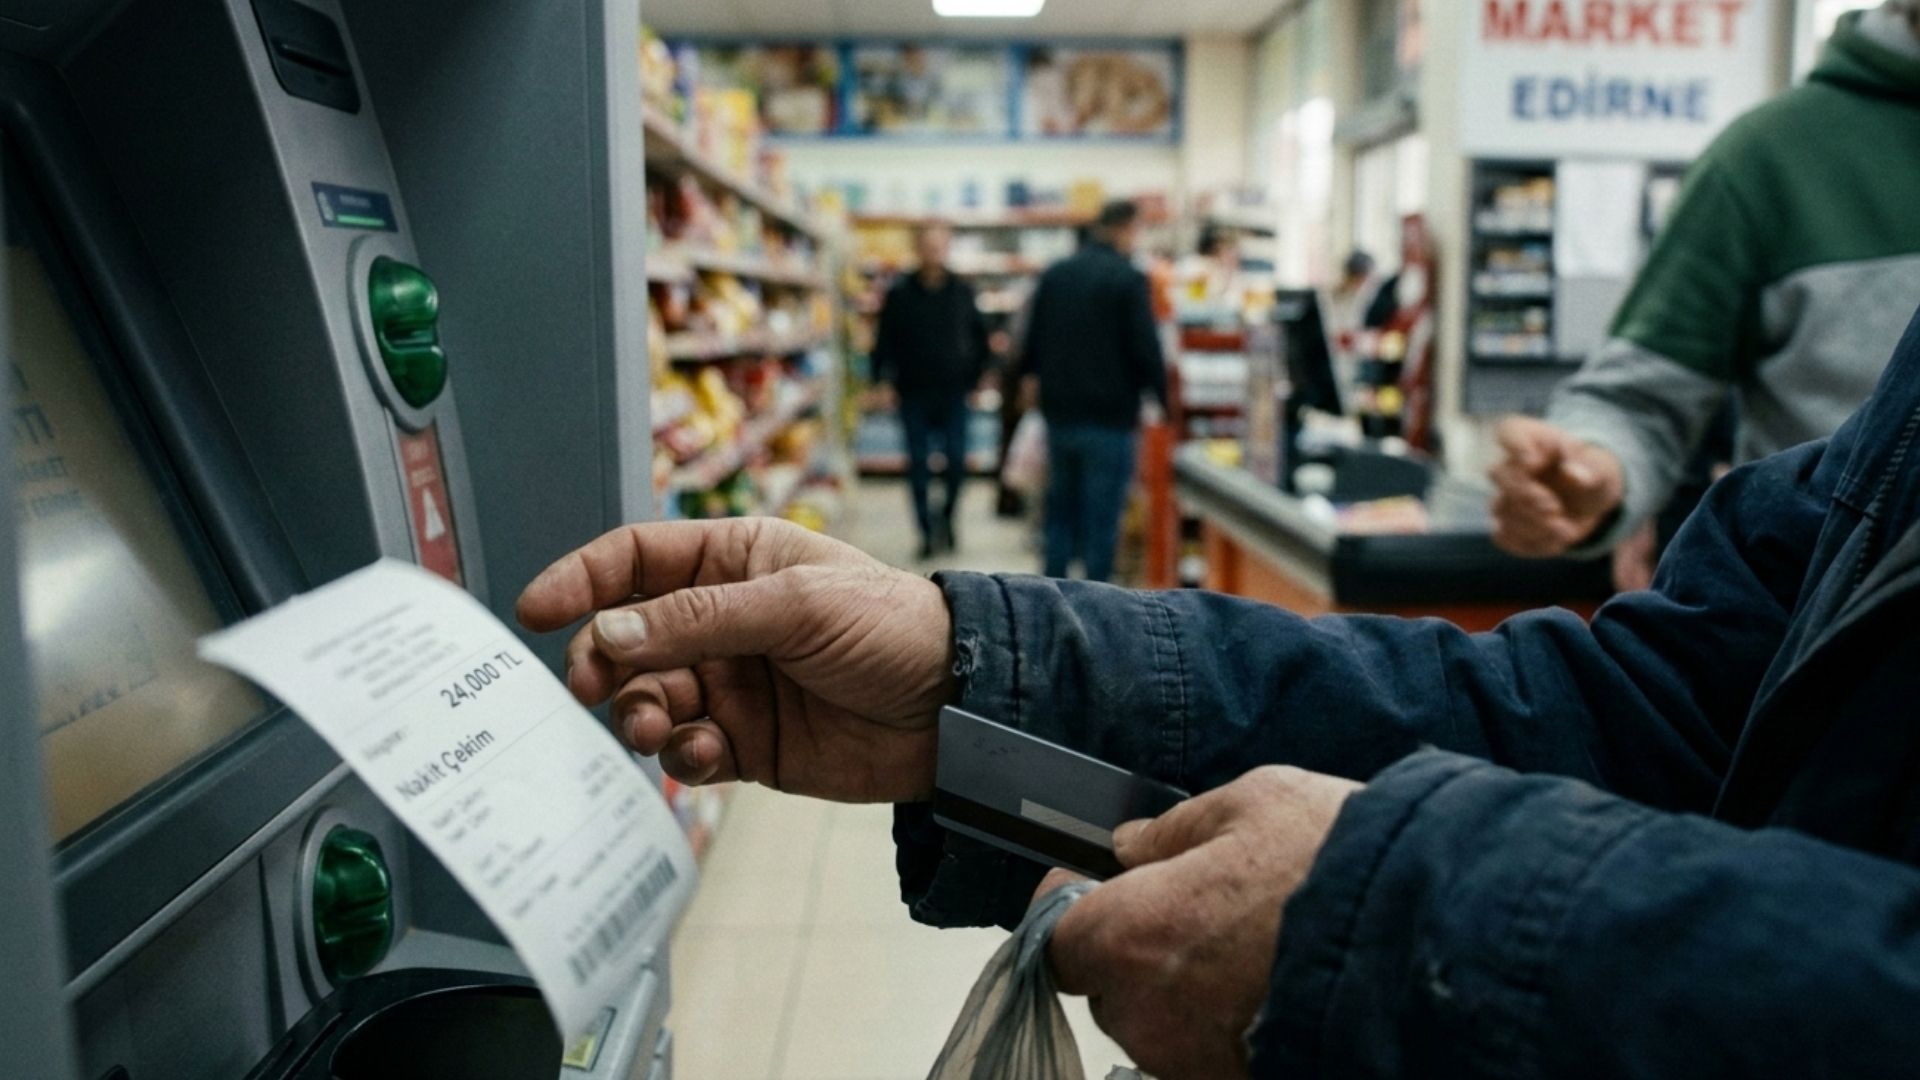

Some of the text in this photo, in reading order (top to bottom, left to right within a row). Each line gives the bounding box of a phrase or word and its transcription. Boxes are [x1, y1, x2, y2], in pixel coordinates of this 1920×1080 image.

[1482, 0, 1744, 47] MARKET
[1511, 68, 1708, 121] EDİRNE
[440, 662, 501, 708] 24,000
[494, 650, 523, 670] TL
[396, 762, 447, 802] Nakit
[441, 730, 495, 773] Çekim
